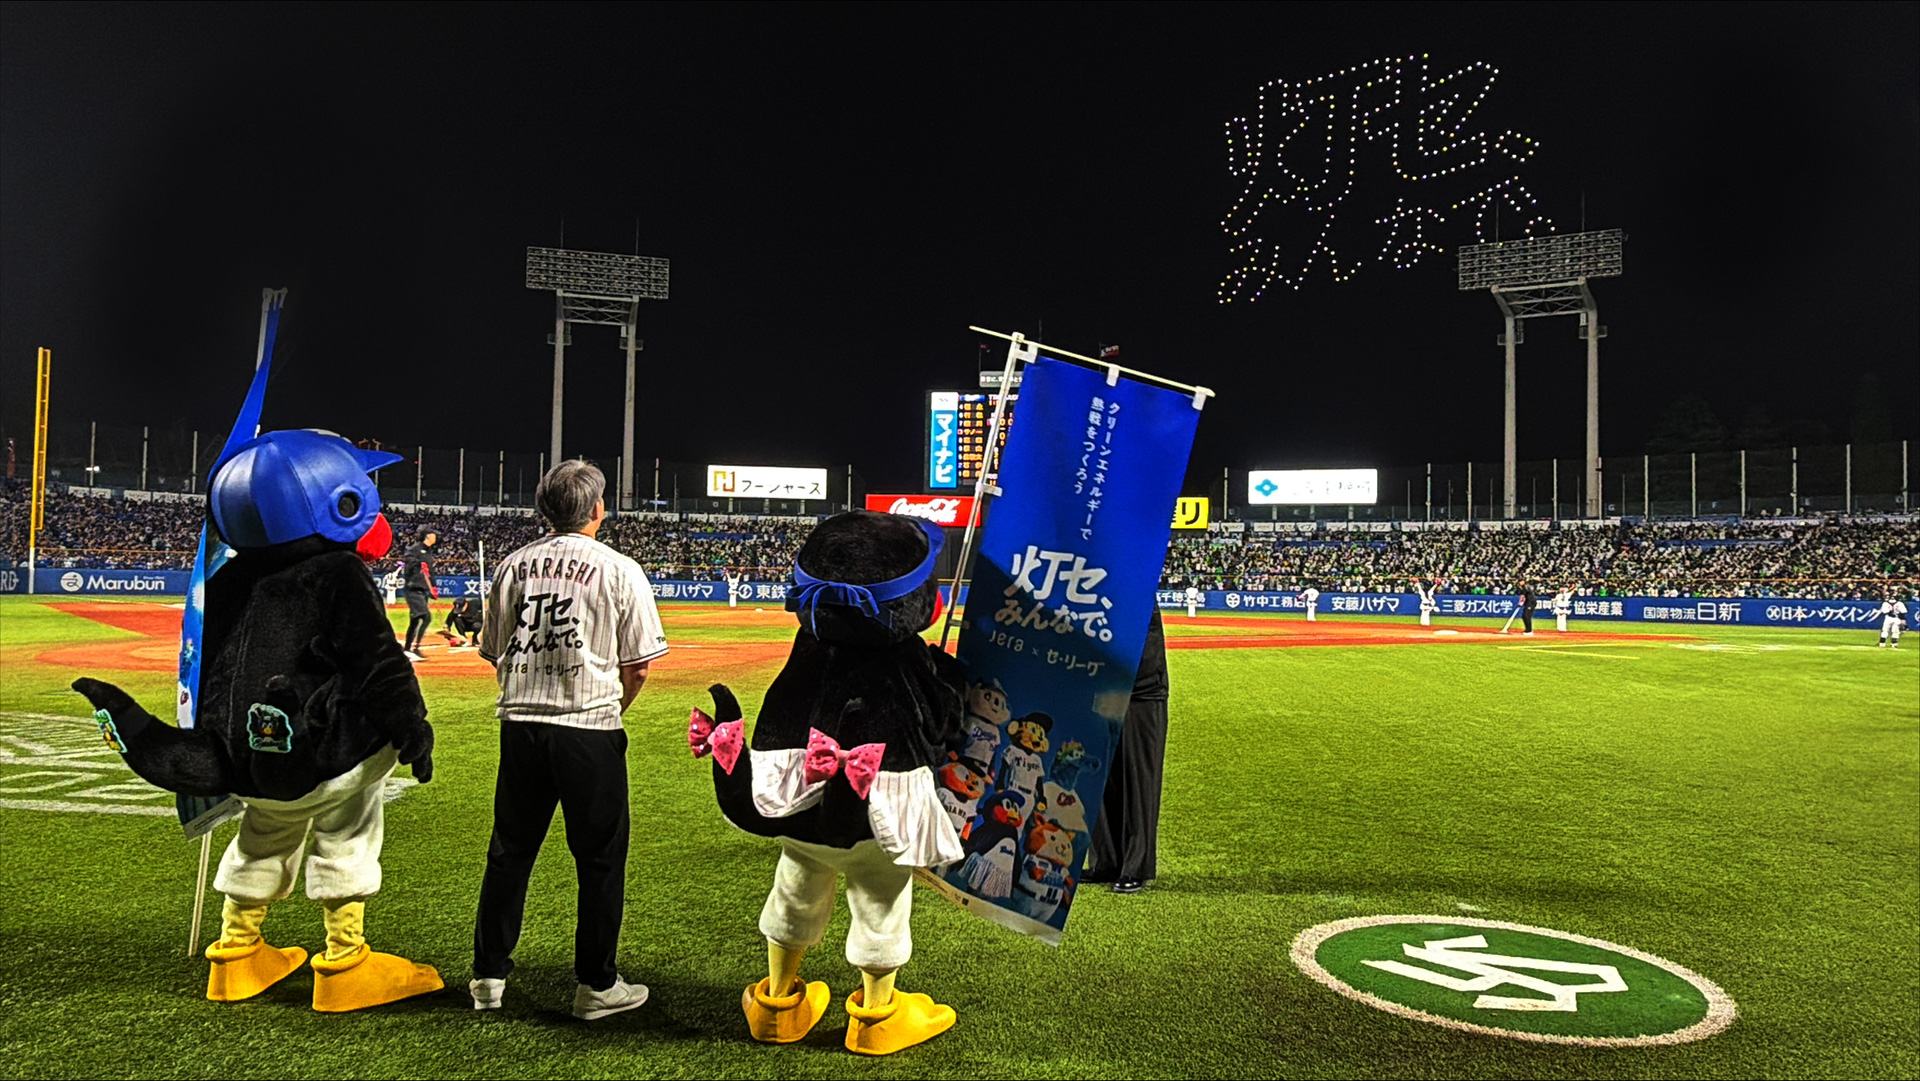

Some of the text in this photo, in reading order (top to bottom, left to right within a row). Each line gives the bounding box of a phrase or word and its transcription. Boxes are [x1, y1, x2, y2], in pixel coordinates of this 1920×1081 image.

[934, 413, 954, 484] マイナビ
[1074, 396, 1106, 495] 熱戦をつくろう
[1079, 402, 1121, 541] クリーンエネルギーで
[87, 575, 165, 591] Marubun
[512, 557, 598, 587] IGARASHI
[1003, 545, 1113, 610] 灯セ、
[651, 583, 714, 599] 安藤ハザマ
[1243, 595, 1306, 608] 竹中工務店
[1331, 596, 1400, 612] 安藤ハザマ
[513, 592, 581, 632] 灯セ、
[994, 599, 1113, 643] みんなで。
[1441, 599, 1513, 614] 三菱ガス化学
[1573, 600, 1623, 616] 協栄産業
[1780, 605, 1882, 623] 日本ハウズイング
[1046, 648, 1106, 677] セ・リーグ
